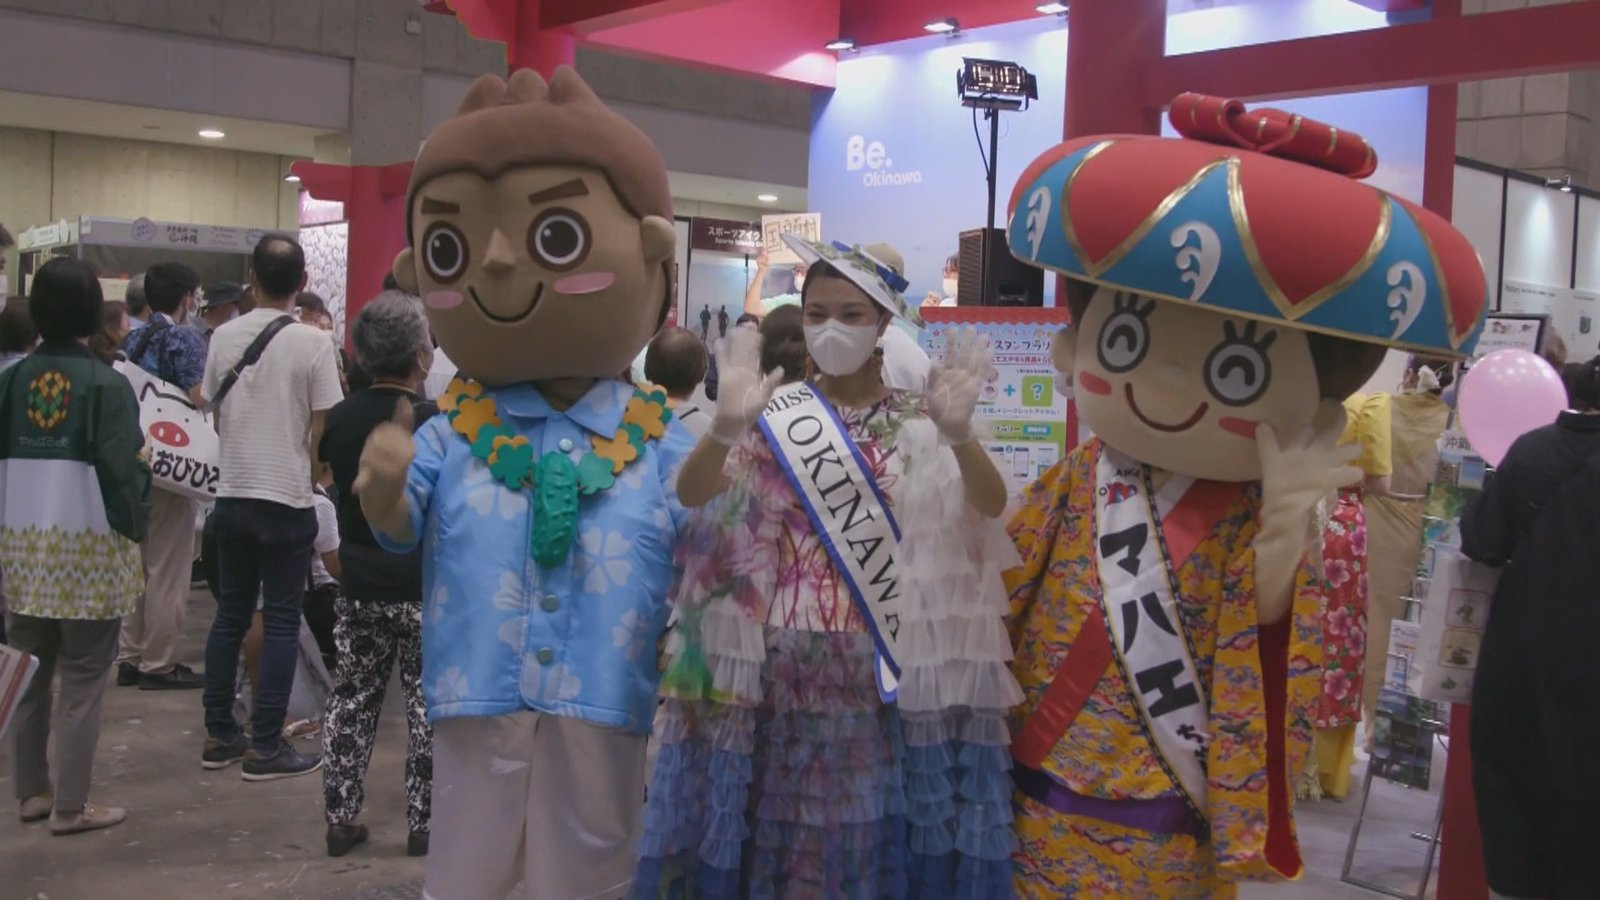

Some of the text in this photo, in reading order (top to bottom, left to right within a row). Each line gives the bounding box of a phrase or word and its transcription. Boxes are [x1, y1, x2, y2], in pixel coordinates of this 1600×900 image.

[846, 135, 892, 171] Be.
[863, 170, 922, 187] Okinawa
[707, 226, 762, 241] スポーツアイラ
[763, 386, 814, 417] MISS
